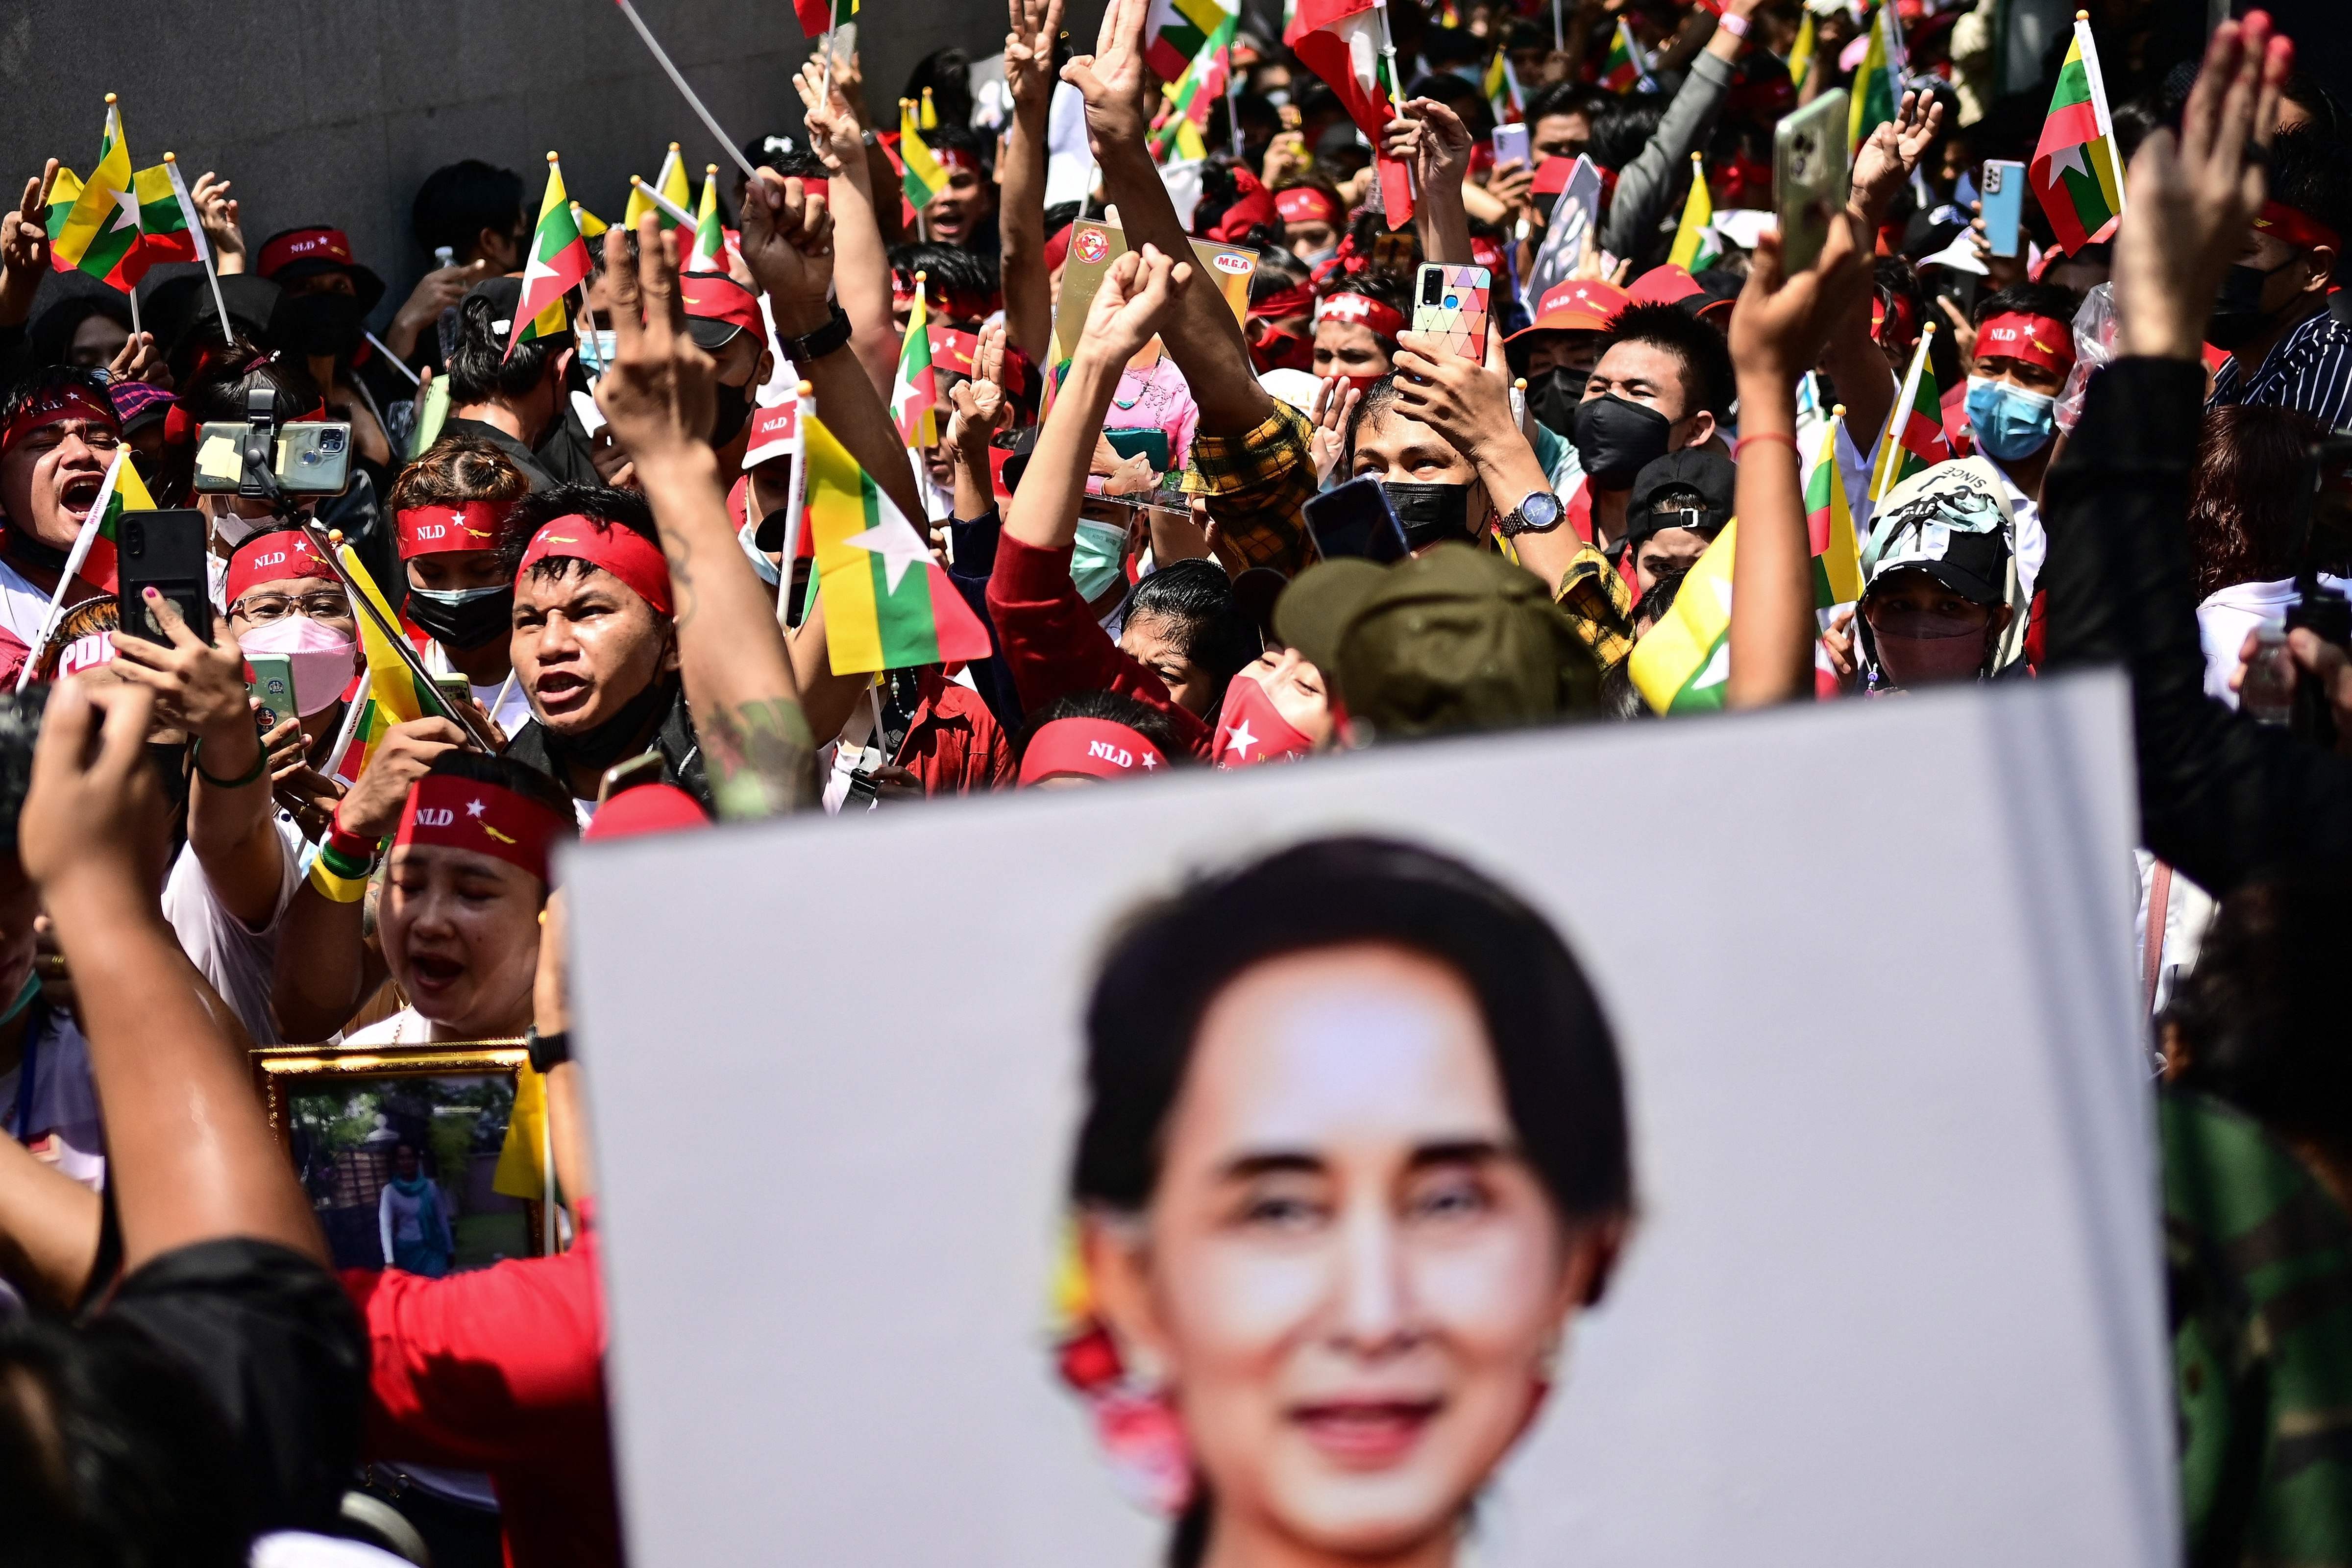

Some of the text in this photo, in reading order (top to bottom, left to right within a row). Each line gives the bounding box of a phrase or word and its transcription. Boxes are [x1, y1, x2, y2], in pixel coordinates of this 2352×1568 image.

[291, 243, 315, 254] NLD
[1218, 257, 1248, 270] M.G.A
[1991, 328, 2016, 342] NLD
[762, 417, 787, 433] NLD
[1942, 466, 1987, 489] SINCE
[417, 525, 445, 539] NLD
[254, 552, 285, 569] NLD
[1087, 740, 1133, 768] NLD
[413, 809, 453, 827] NLD
